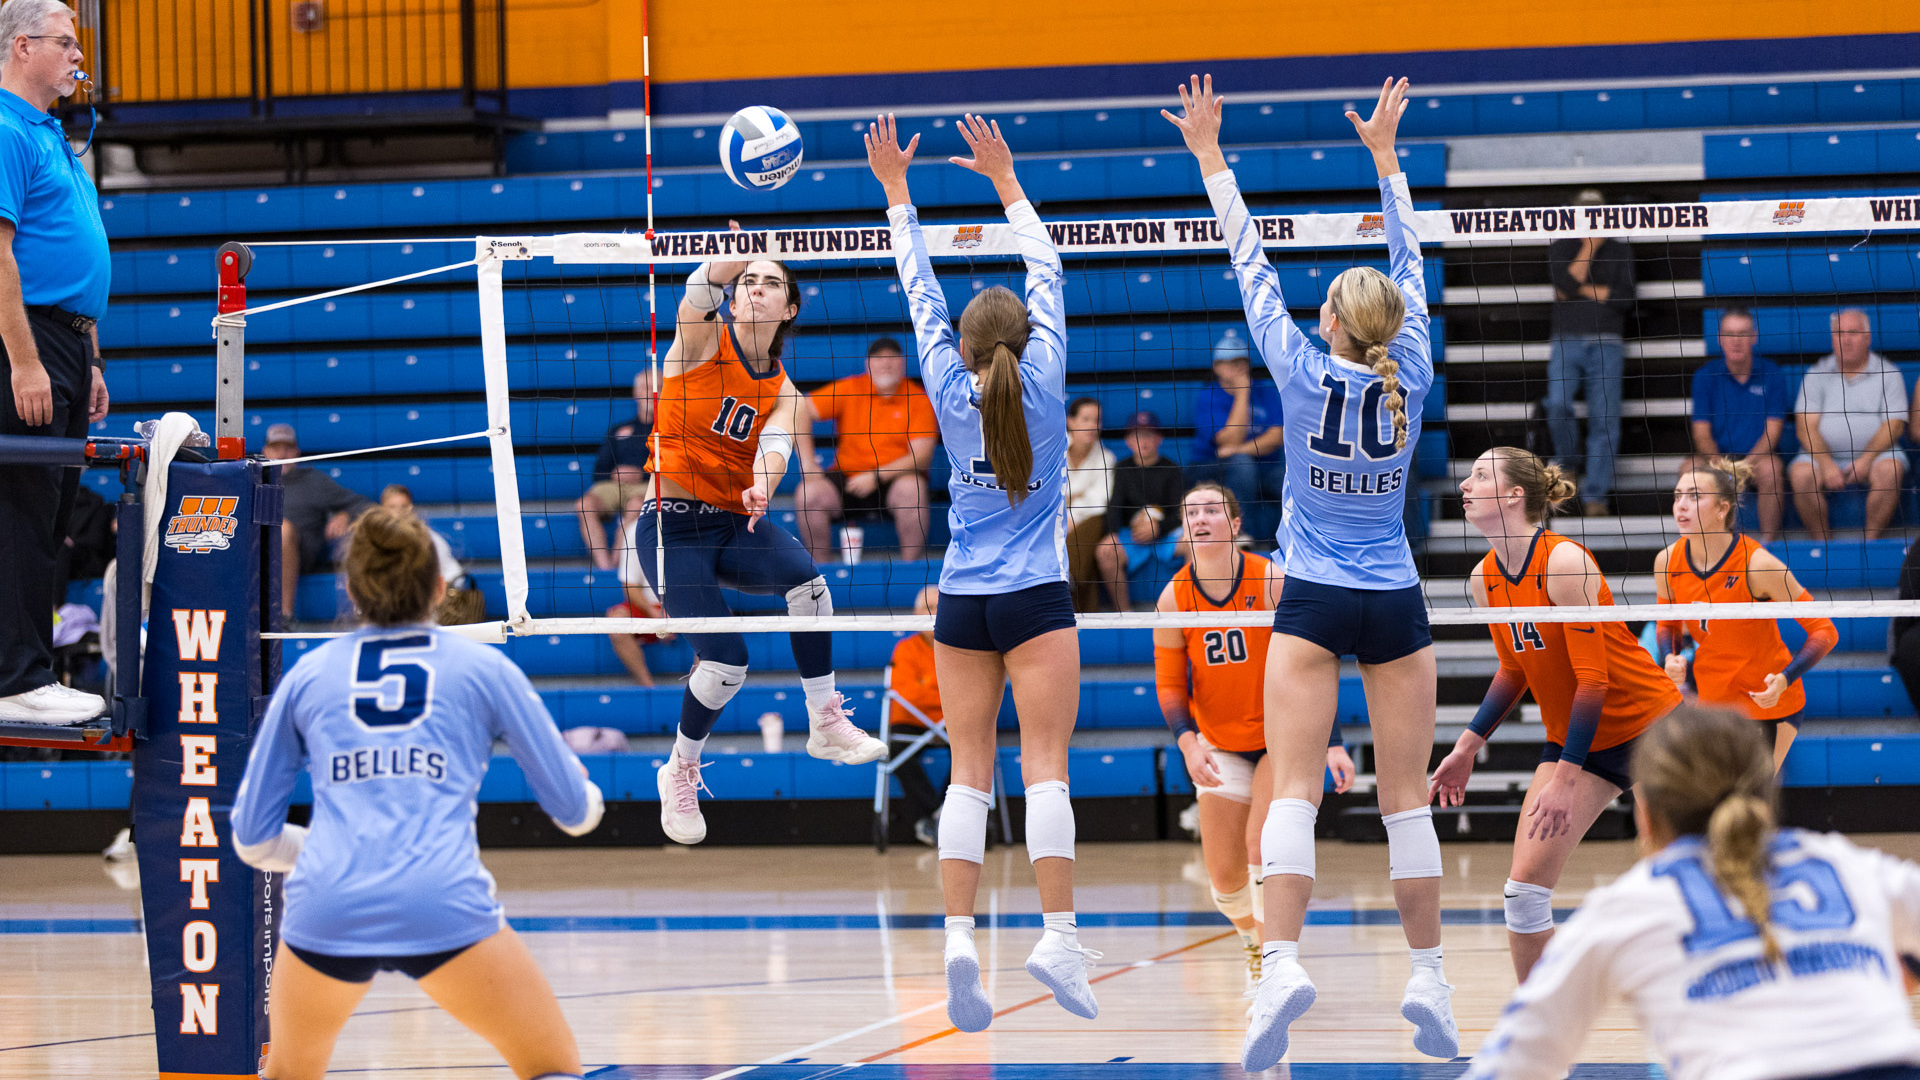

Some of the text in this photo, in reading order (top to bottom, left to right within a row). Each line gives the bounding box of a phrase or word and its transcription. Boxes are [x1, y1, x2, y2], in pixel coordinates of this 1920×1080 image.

[758, 158, 800, 182] molten
[1046, 217, 1295, 246] WHEATON THUER
[1450, 205, 1709, 234] WHEATON THUNDER
[650, 229, 893, 257] WHEATON THUNDER
[711, 395, 758, 442] 10
[1307, 370, 1410, 462] 10
[1308, 463, 1404, 496] BELLES
[168, 515, 238, 536] THUNDER
[1203, 628, 1249, 667] 20
[1507, 621, 1546, 653] 14
[349, 630, 437, 734] 5
[330, 744, 447, 784] BELLES
[171, 609, 227, 1035] WHEATON
[264, 869, 273, 926] ports
[1650, 855, 1856, 958] 15
